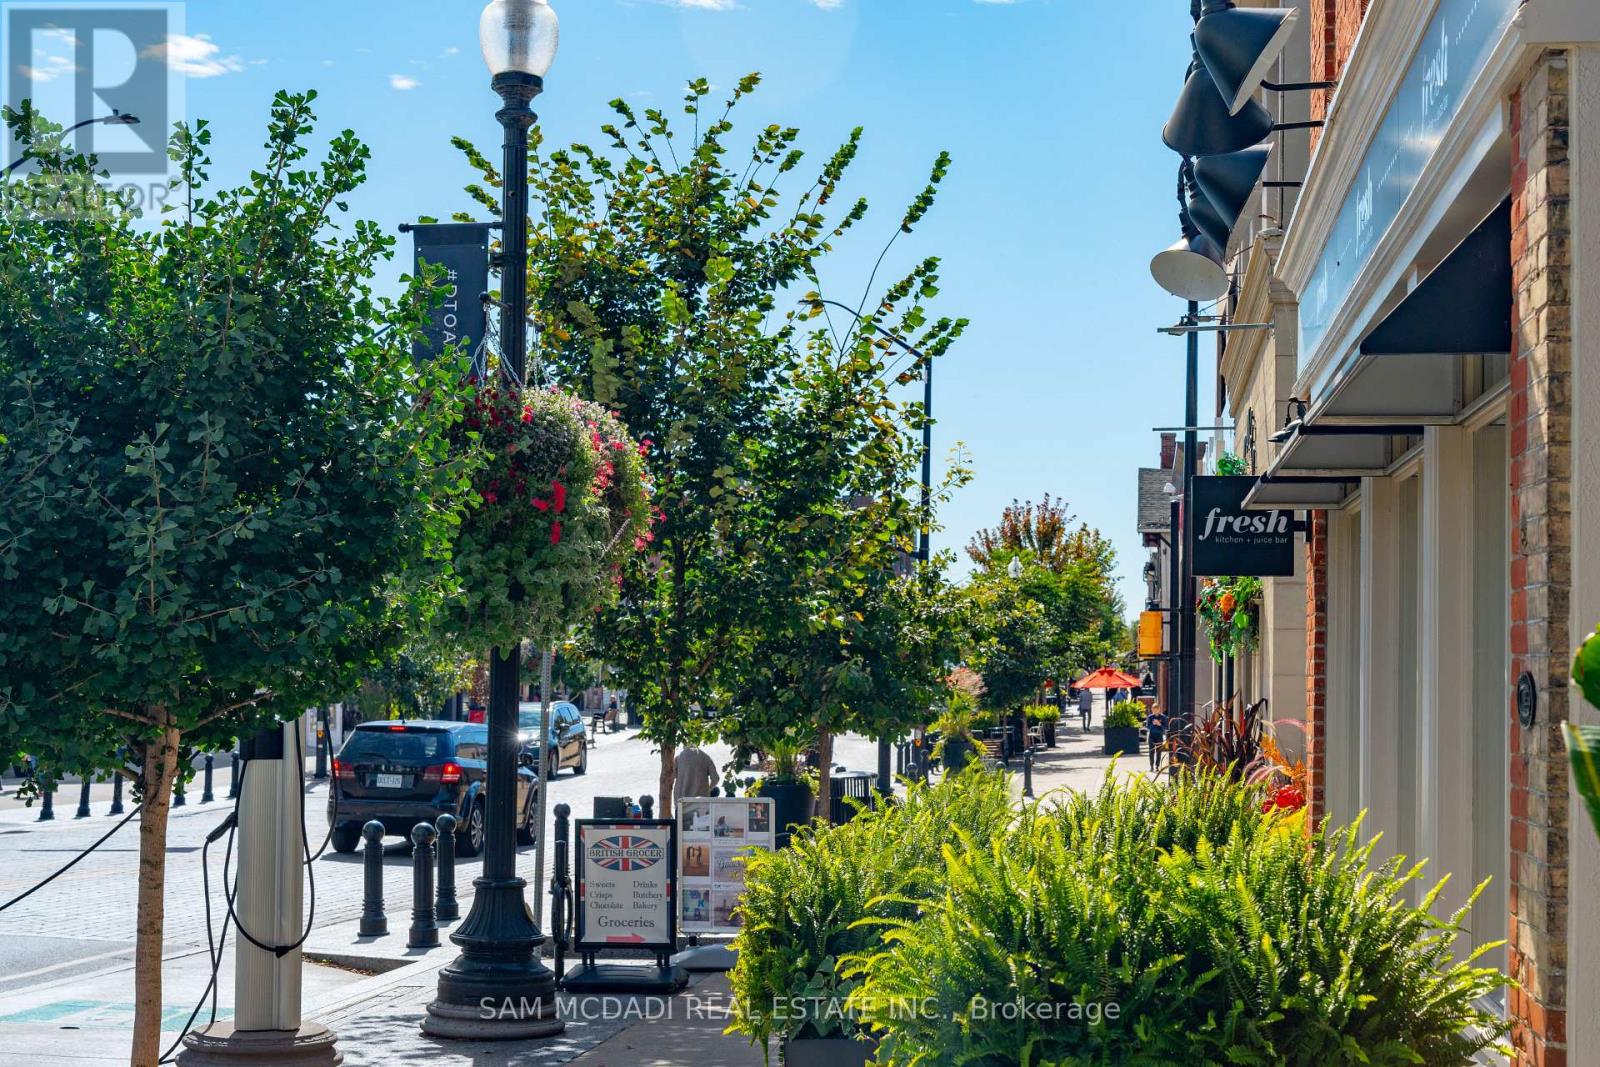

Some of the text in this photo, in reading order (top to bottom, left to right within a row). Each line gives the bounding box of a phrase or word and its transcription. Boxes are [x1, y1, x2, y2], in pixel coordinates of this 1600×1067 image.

[1199, 507, 1289, 541] fresh
[1215, 535, 1244, 544] kitchen
[1253, 535, 1273, 545] juice
[1275, 535, 1288, 544] bar
[589, 849, 662, 857] BRITISH GROCER
[633, 880, 659, 888] Drinks
[589, 891, 613, 900] Crisps
[589, 901, 658, 911] Chocolate Bakery
[598, 915, 655, 927] Groceries
